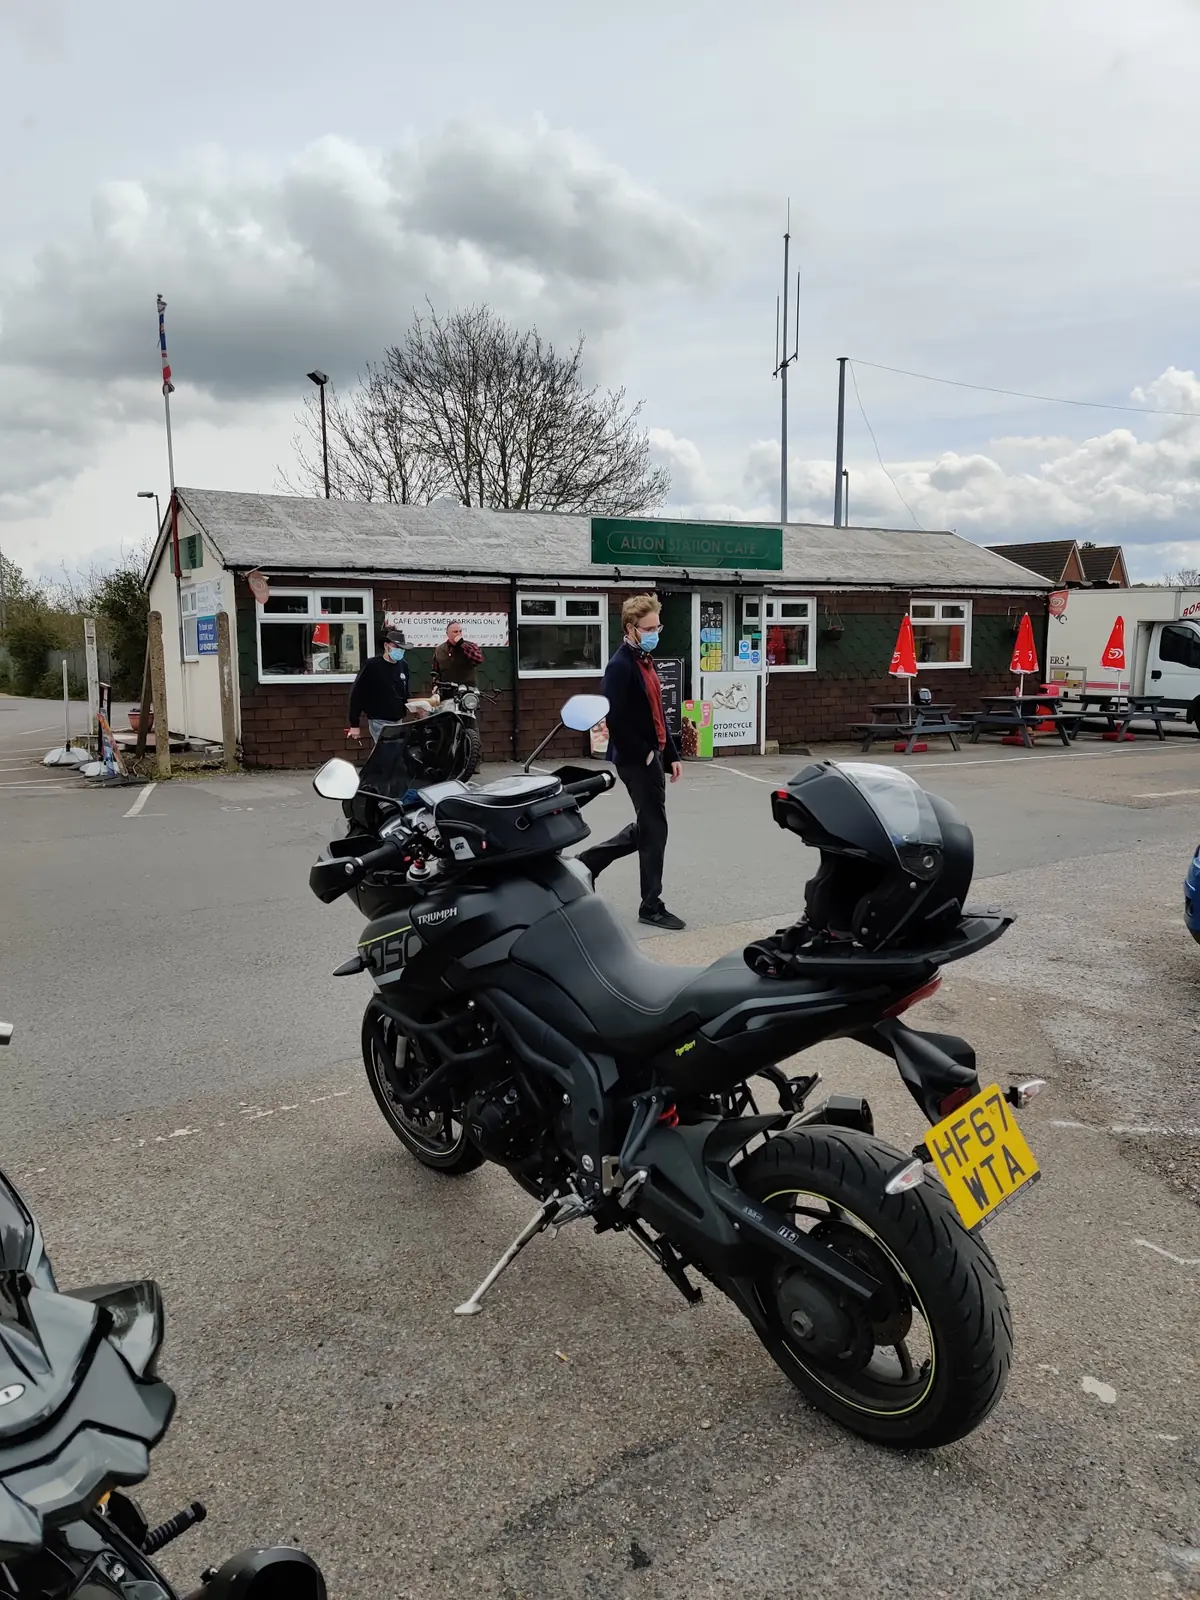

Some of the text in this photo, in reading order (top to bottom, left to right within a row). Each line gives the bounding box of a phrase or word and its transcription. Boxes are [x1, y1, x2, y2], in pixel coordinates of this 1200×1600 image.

[620, 536, 757, 555] ALTON STATION CAFE
[713, 721, 753, 730] OTORCYCLE
[713, 731, 746, 739] FRIENDLY
[417, 907, 458, 926] TRIUMPH
[931, 1093, 1009, 1177] HF67
[962, 1144, 1026, 1211] WTA
